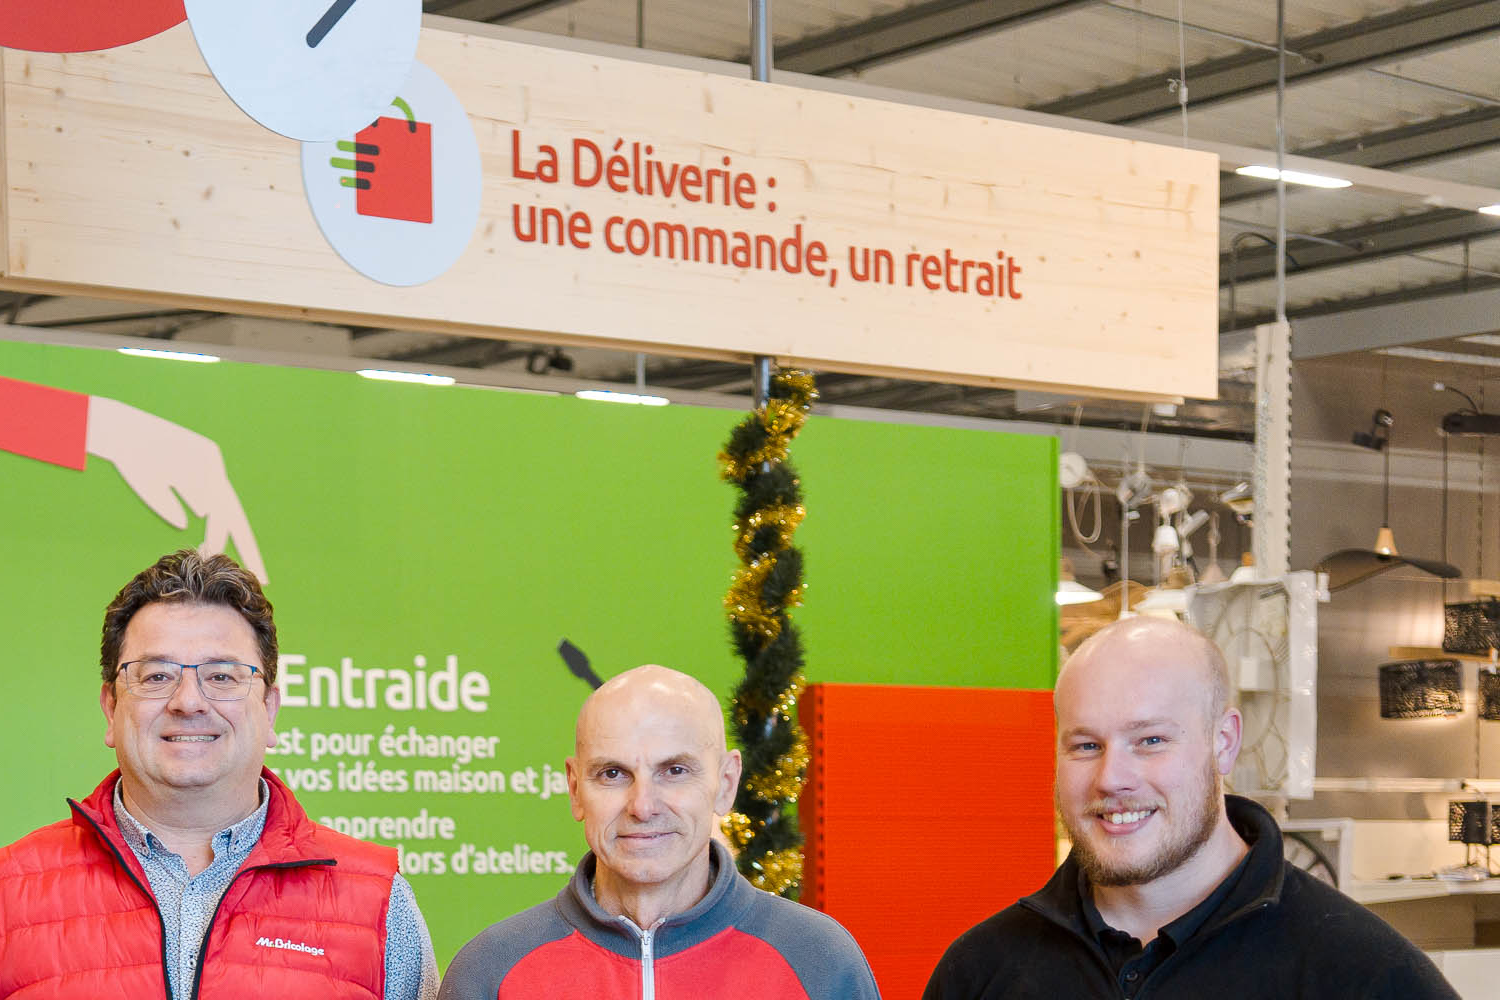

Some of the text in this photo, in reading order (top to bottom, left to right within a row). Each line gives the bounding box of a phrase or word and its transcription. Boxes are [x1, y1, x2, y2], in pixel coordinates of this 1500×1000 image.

[511, 129, 559, 184] La
[572, 137, 757, 211] Déliverie
[512, 203, 1023, 300] une commande, un retrait
[277, 653, 491, 712] Entraide
[311, 732, 374, 762] pour
[379, 723, 500, 764] échanger
[284, 768, 333, 792] vos
[338, 761, 409, 793] idées
[414, 764, 505, 794] maison
[510, 769, 538, 794] et
[540, 763, 570, 800] ja
[451, 843, 576, 875] d'ateliers.
